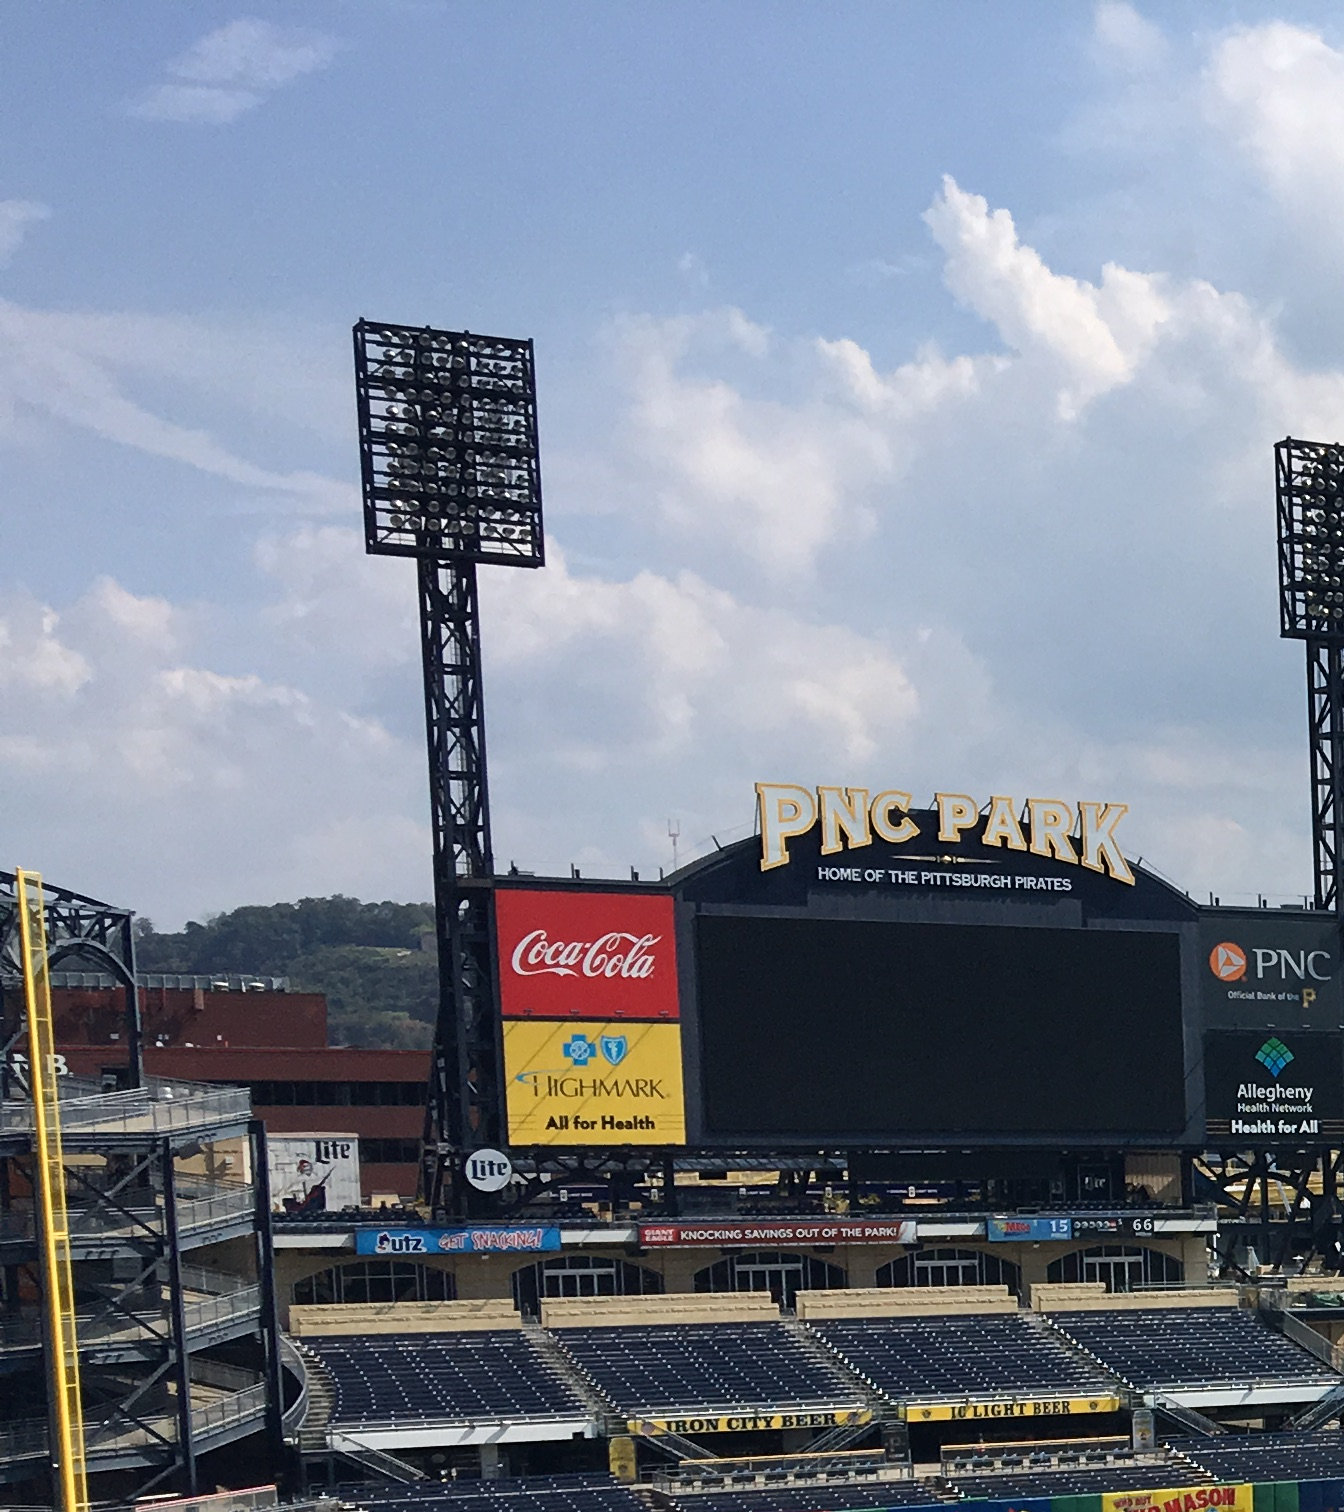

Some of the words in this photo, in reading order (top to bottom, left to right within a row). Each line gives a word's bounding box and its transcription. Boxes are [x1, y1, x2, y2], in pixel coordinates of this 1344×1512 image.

[755, 782, 921, 872] PNC
[934, 793, 1135, 886] PARK
[817, 866, 861, 882] HOME
[864, 869, 886, 883] OF
[888, 870, 918, 884] THE
[921, 872, 1011, 889] PITTSBURGH
[1014, 876, 1072, 891] PIRATES
[512, 930, 662, 979] Coca-Cola
[1252, 948, 1331, 981] PNC
[533, 1076, 667, 1100] HIGHMARK
[1237, 1084, 1313, 1102] Allegheny
[1237, 1103, 1269, 1113] Health
[1272, 1103, 1312, 1113] Network
[545, 1115, 569, 1130] All
[573, 1115, 597, 1130] for
[602, 1115, 655, 1130] Health
[1231, 1120, 1276, 1134] Health
[1278, 1120, 1298, 1134] for
[1299, 1119, 1319, 1134] All
[315, 1141, 351, 1163] Lite
[471, 1159, 507, 1180] Lite
[680, 1230, 743, 1241] KNOCKING
[745, 1228, 793, 1240] SAVINGS
[796, 1228, 819, 1239] OUT
[822, 1227, 839, 1238] OF
[841, 1227, 863, 1237] THE
[865, 1226, 897, 1237] PARK!
[1050, 1219, 1068, 1232] 15
[1132, 1218, 1152, 1231] 66
[439, 1233, 468, 1249] GET
[471, 1229, 543, 1250] SNACKING!
[973, 1403, 1027, 1418] LIGHT
[1033, 1401, 1071, 1416] BEER
[666, 1418, 719, 1433] IRON
[727, 1416, 775, 1430] CITY
[781, 1413, 836, 1428] BEER
